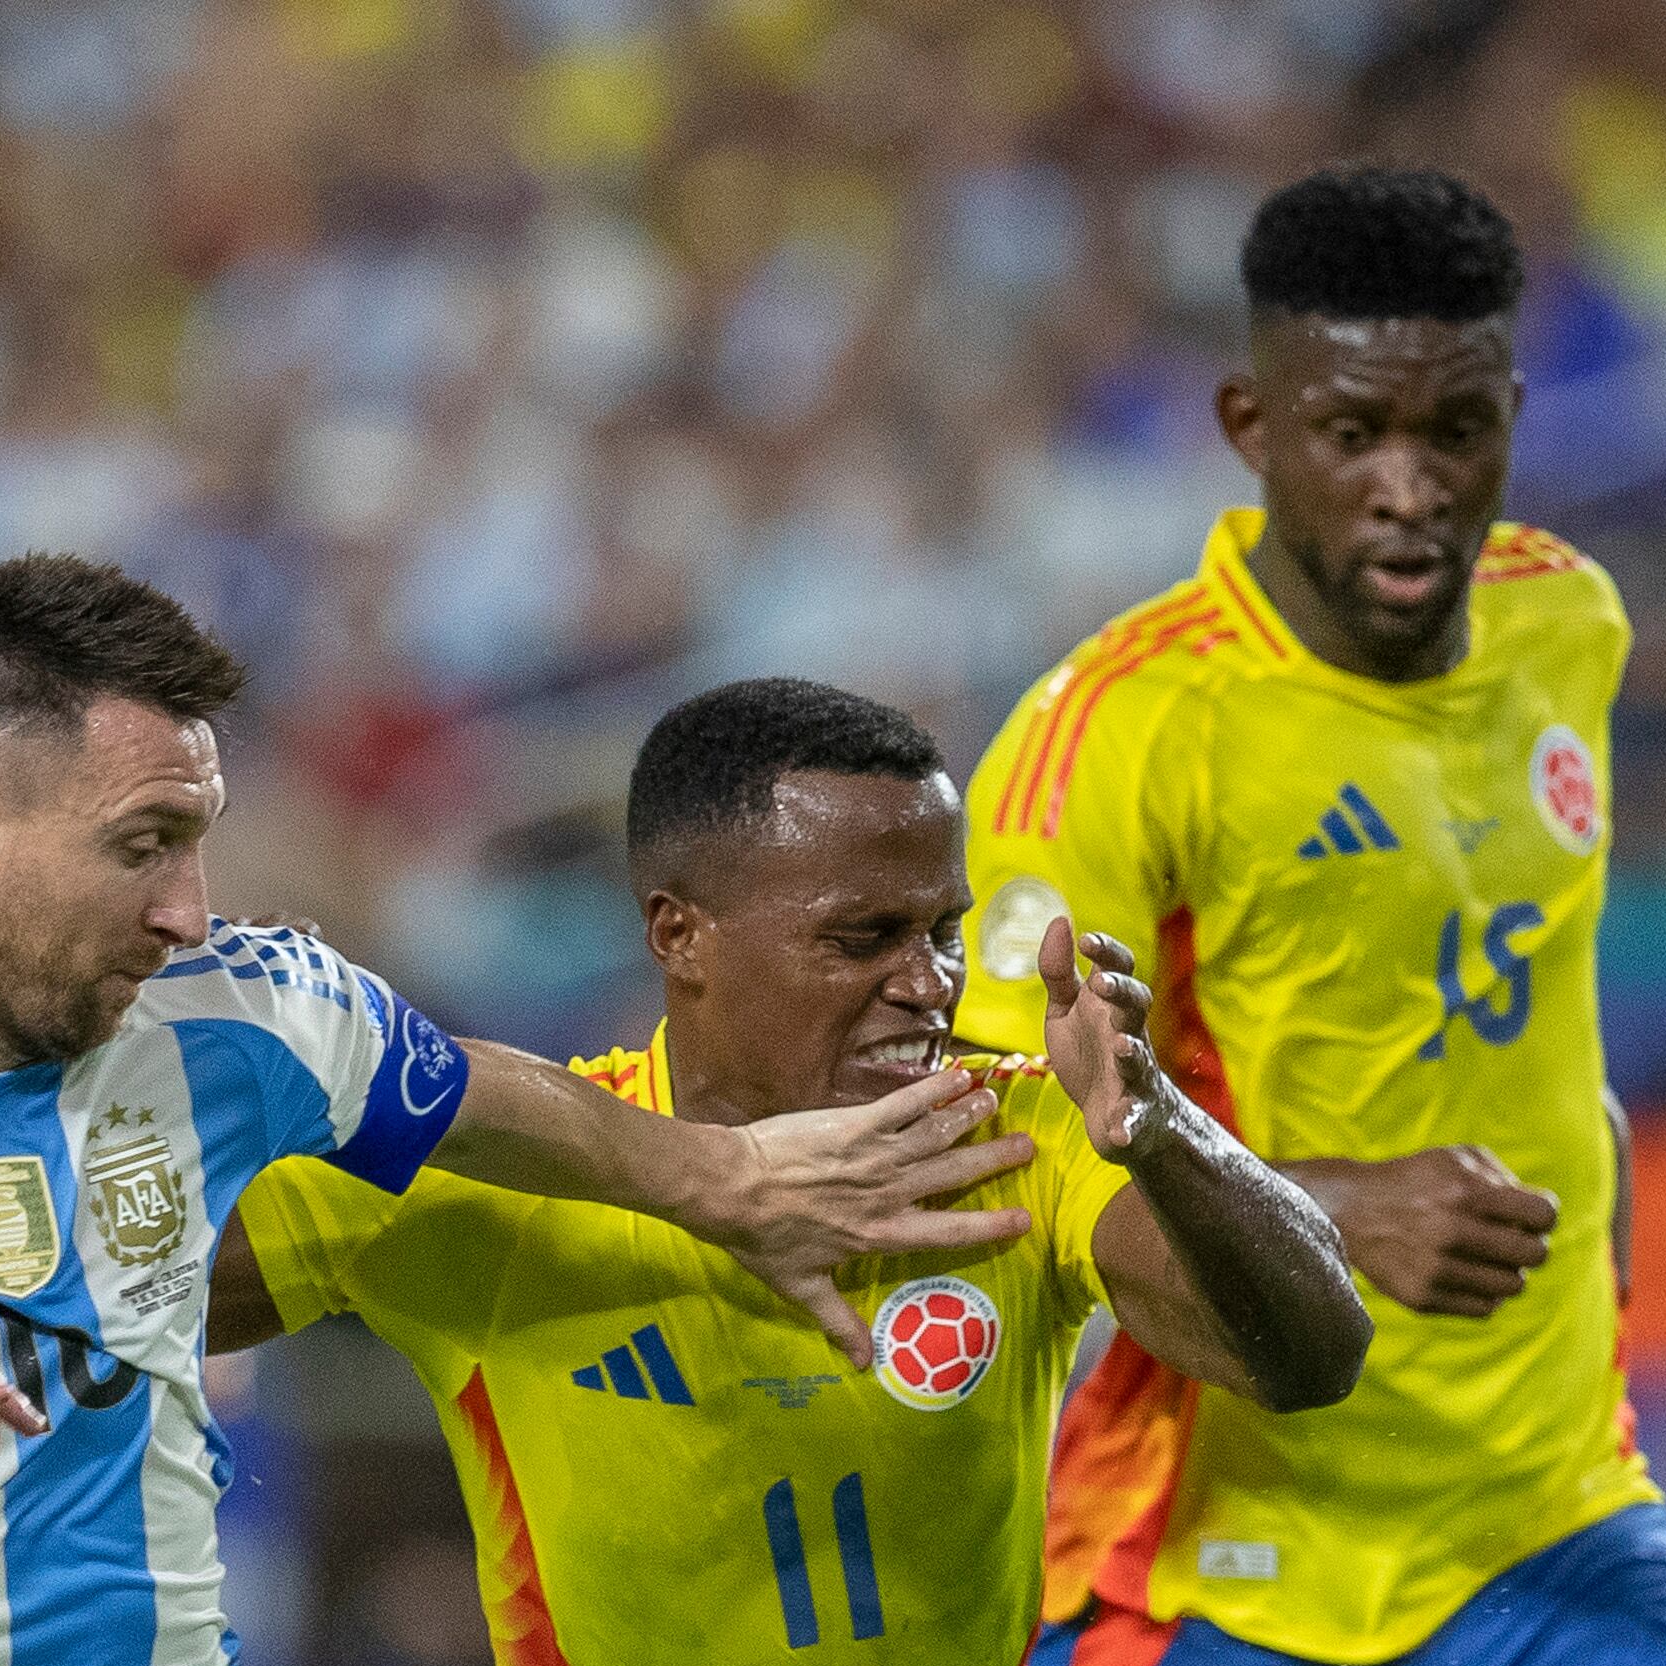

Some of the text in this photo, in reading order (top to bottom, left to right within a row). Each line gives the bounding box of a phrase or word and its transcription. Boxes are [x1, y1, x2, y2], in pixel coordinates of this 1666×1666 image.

[115, 1170, 173, 1228] AFA
[5, 1318, 141, 1432] 10
[763, 1472, 885, 1649] 11
